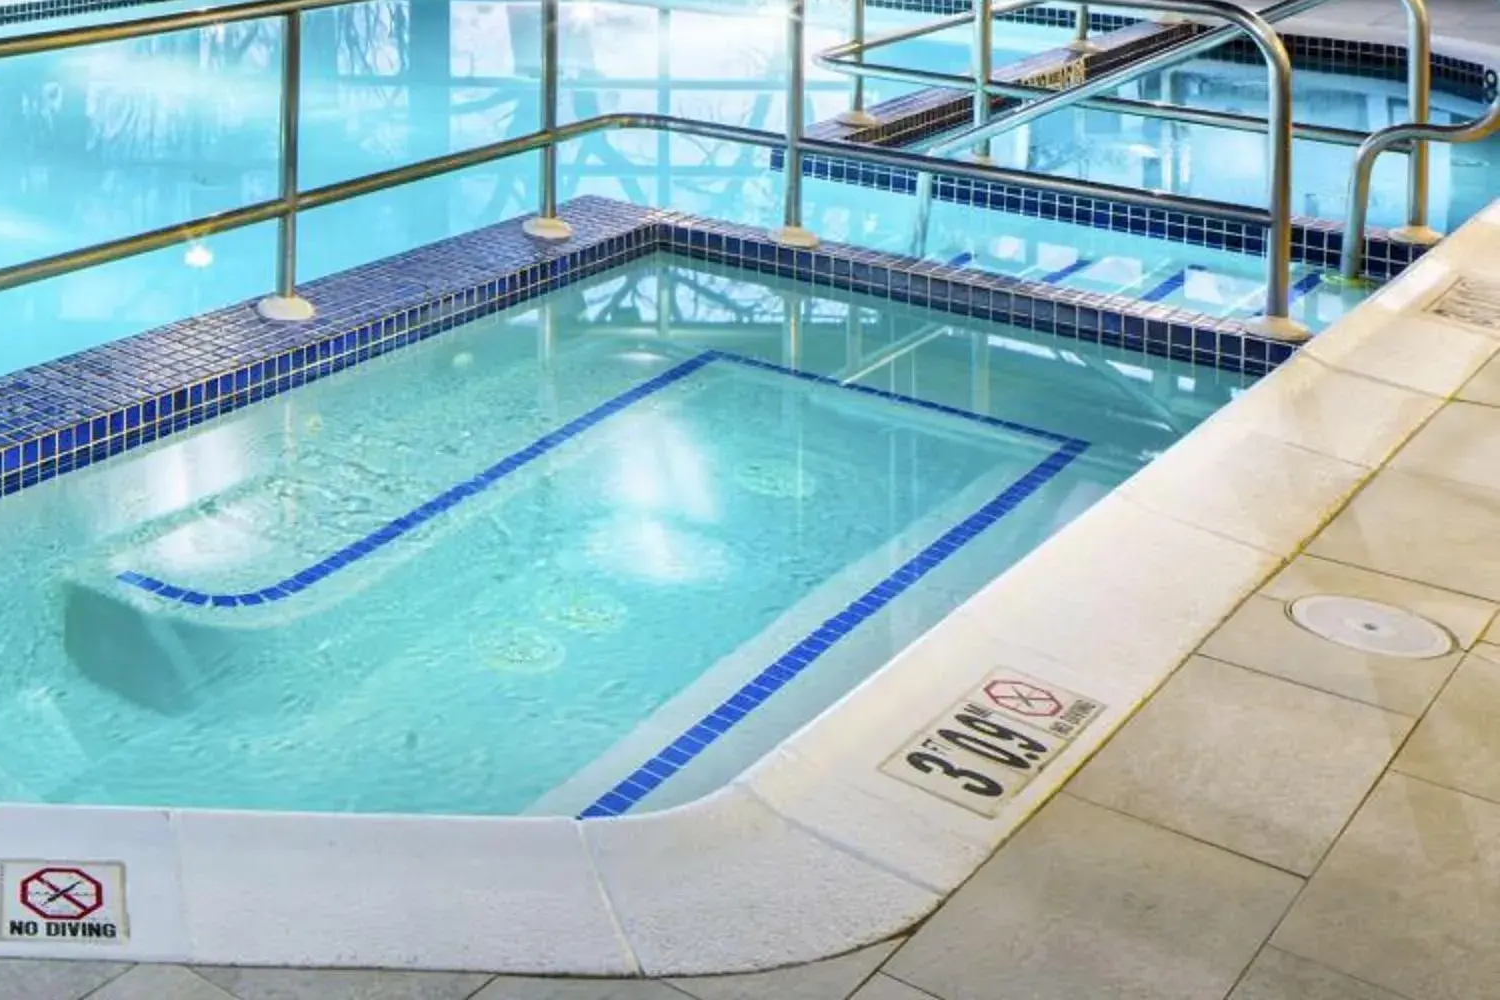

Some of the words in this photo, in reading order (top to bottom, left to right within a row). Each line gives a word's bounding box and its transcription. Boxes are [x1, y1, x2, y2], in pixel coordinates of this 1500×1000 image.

[937, 713, 1047, 769] 0.9
[906, 751, 1004, 797] 3
[9, 920, 39, 936] NO
[45, 922, 118, 938] DIVING
